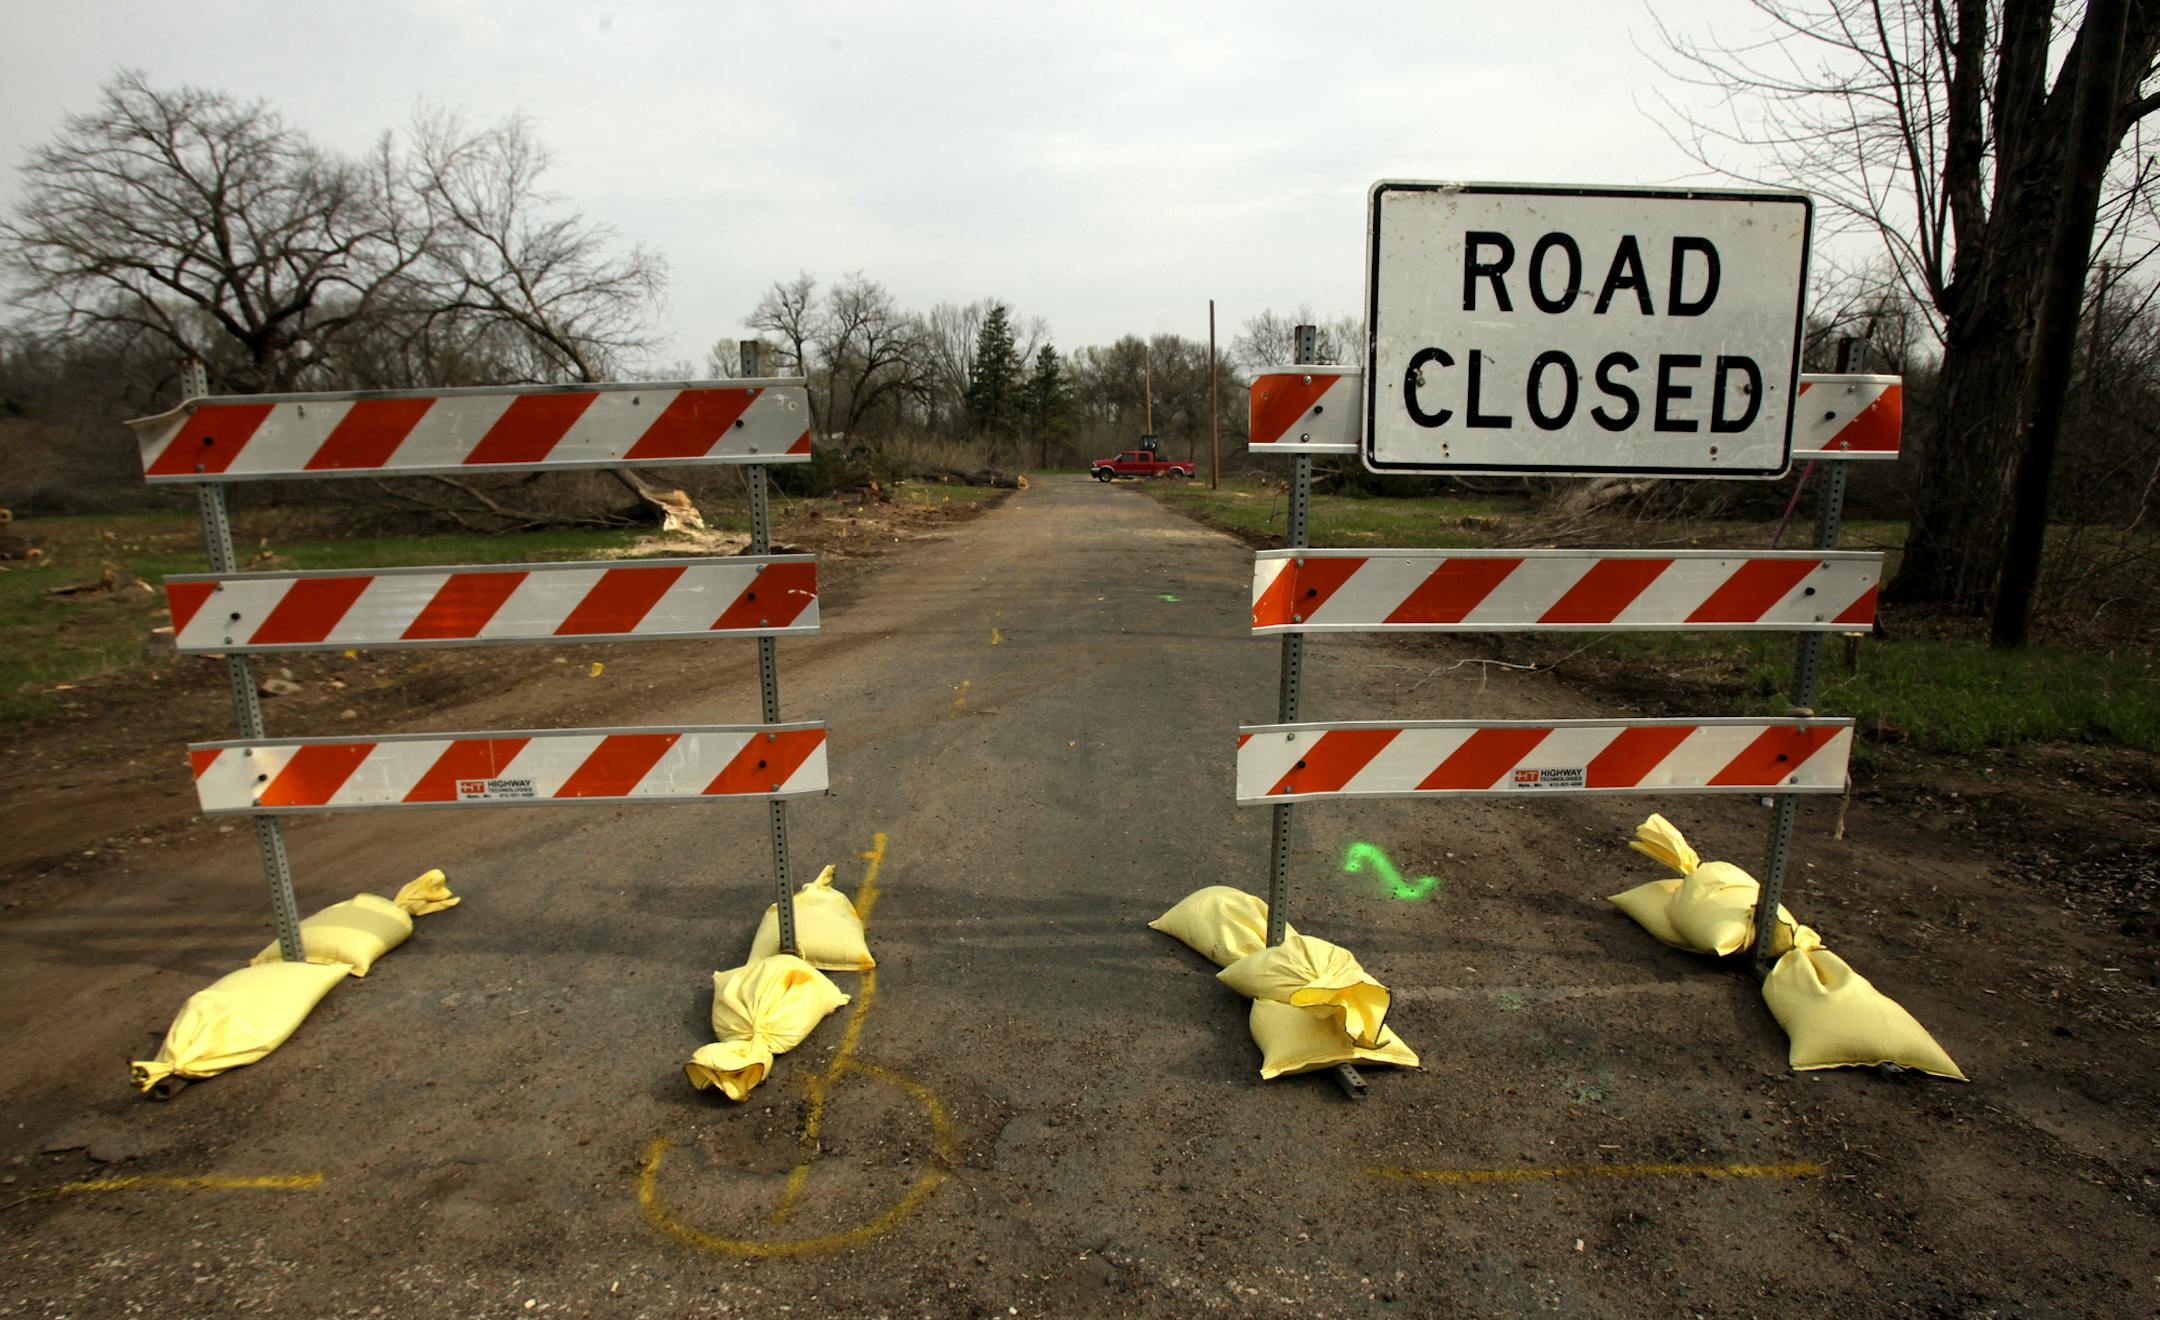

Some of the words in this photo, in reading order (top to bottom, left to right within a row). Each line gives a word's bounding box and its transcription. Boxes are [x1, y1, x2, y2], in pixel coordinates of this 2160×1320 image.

[1463, 231, 1721, 317] ROAD
[1403, 347, 1763, 434] CLOSED
[1541, 769, 1582, 777] HIGHWAY
